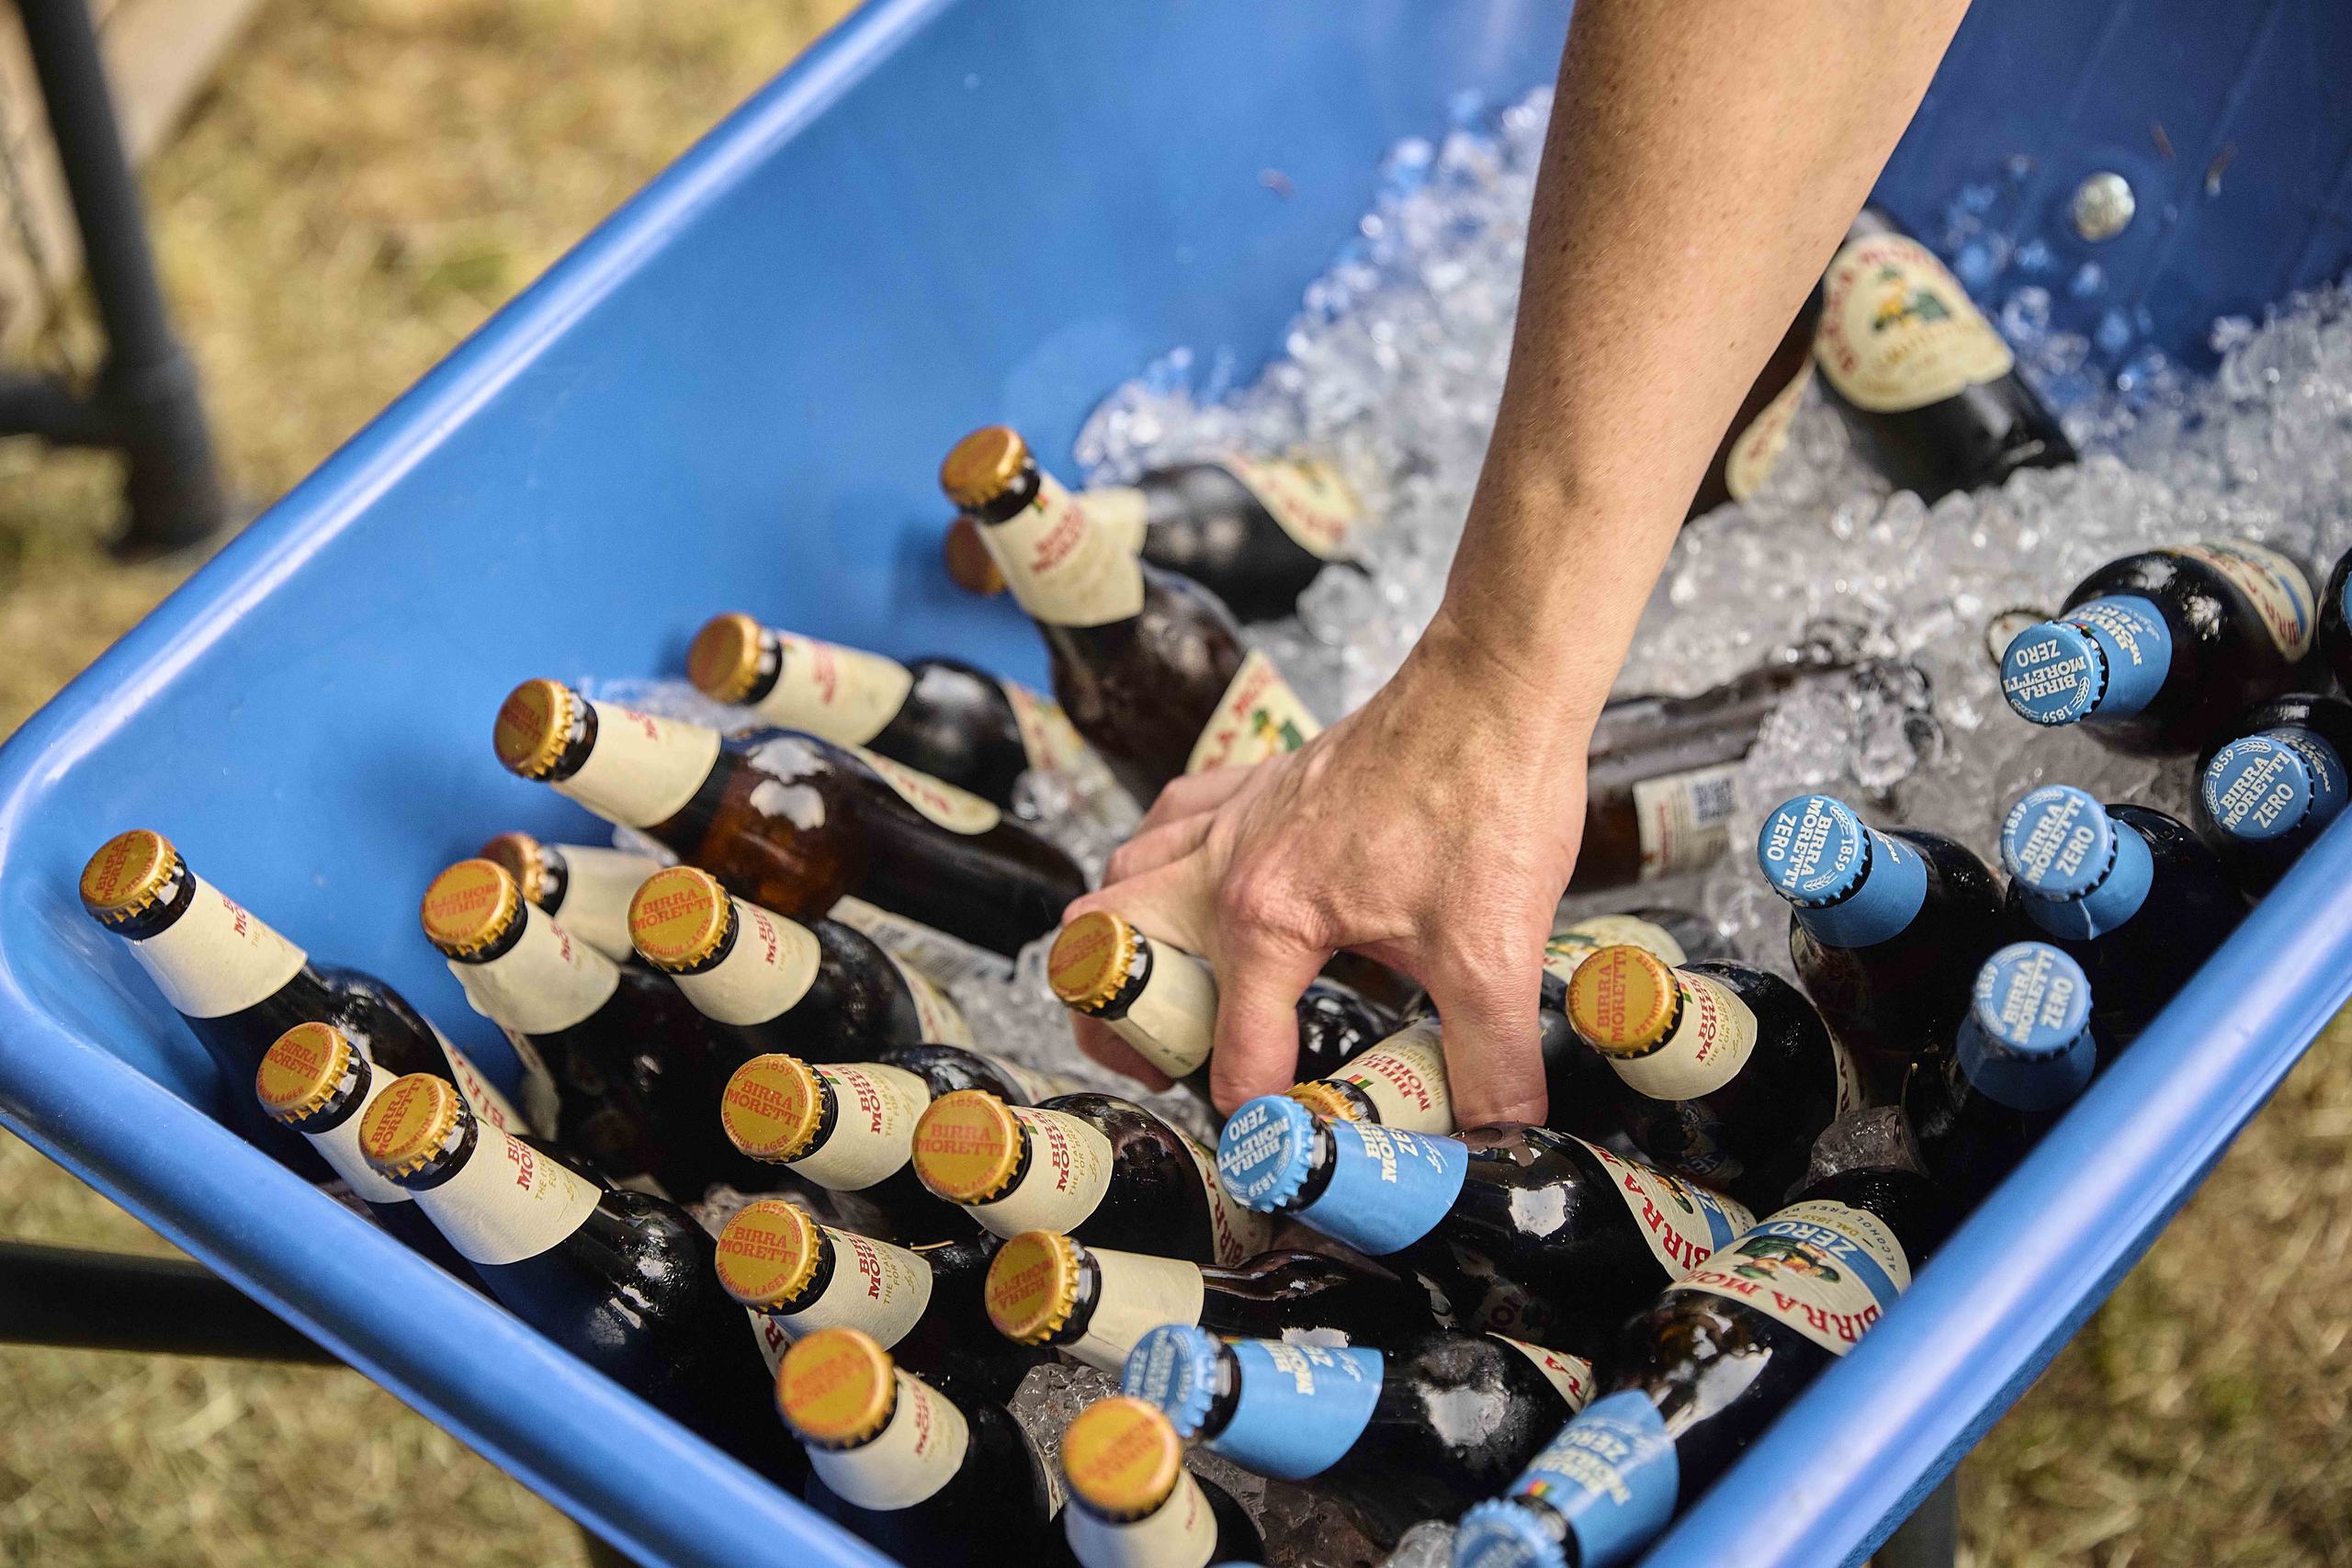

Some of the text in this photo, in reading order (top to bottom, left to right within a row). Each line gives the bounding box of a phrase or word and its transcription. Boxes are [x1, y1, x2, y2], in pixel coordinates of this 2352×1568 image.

[2016, 639, 2061, 668] ZERO
[2003, 656, 2086, 694] MORETTI
[2018, 673, 2078, 702] BIRRA
[2041, 705, 2074, 724] 1859
[2209, 749, 2234, 779] 1859
[2220, 757, 2269, 810] BIRRA
[2222, 752, 2291, 830] MORETTI
[2004, 802, 2027, 835] 1859
[2252, 783, 2294, 829] ZERO
[1766, 812, 1798, 862] ZERO
[1782, 797, 1825, 888] MORETTI
[1800, 815, 1833, 876] BIRRA
[2020, 804, 2065, 864] BIRRA
[2025, 795, 2086, 886] MORETTI
[2054, 826, 2096, 877] ZERO
[1834, 839, 1854, 872] 1859
[631, 896, 714, 932] MORETTI
[643, 888, 699, 913] BIRRA
[1598, 964, 1612, 1028] BIRRA
[1611, 948, 1628, 1043] MORETTI
[2039, 976, 2074, 1030] ZERO
[265, 1049, 321, 1080] MORETTI
[279, 1038, 319, 1065] BIRRA
[764, 1059, 794, 1076] 1859
[1705, 1047, 1720, 1067] THE
[724, 1088, 803, 1129] MORETTI
[741, 1078, 793, 1111] BIRRA
[371, 1088, 409, 1143] BIRRA
[375, 1077, 424, 1157] MORETTI
[722, 1111, 791, 1153] PREMIUM LAGER
[931, 1123, 992, 1142] BIRRA
[1227, 1103, 1269, 1142] ZERO
[915, 1139, 1005, 1157] MORETTI
[1218, 1115, 1291, 1172] MORETTI
[1229, 1137, 1281, 1177] BIRRA
[1068, 1175, 1080, 1195] THE
[755, 1202, 786, 1215] 1859
[1802, 1213, 1860, 1237] DAL 1859
[1809, 1204, 1850, 1216] FREE
[718, 1237, 799, 1266] MORETTI
[734, 1226, 788, 1249] BIRRA
[1768, 1221, 1860, 1260] ZERO
[1856, 1215, 1897, 1272] ALCOHOL
[717, 1261, 789, 1297] PREMIUM LAGER
[883, 1282, 893, 1305] THE
[892, 1264, 900, 1287] FOR
